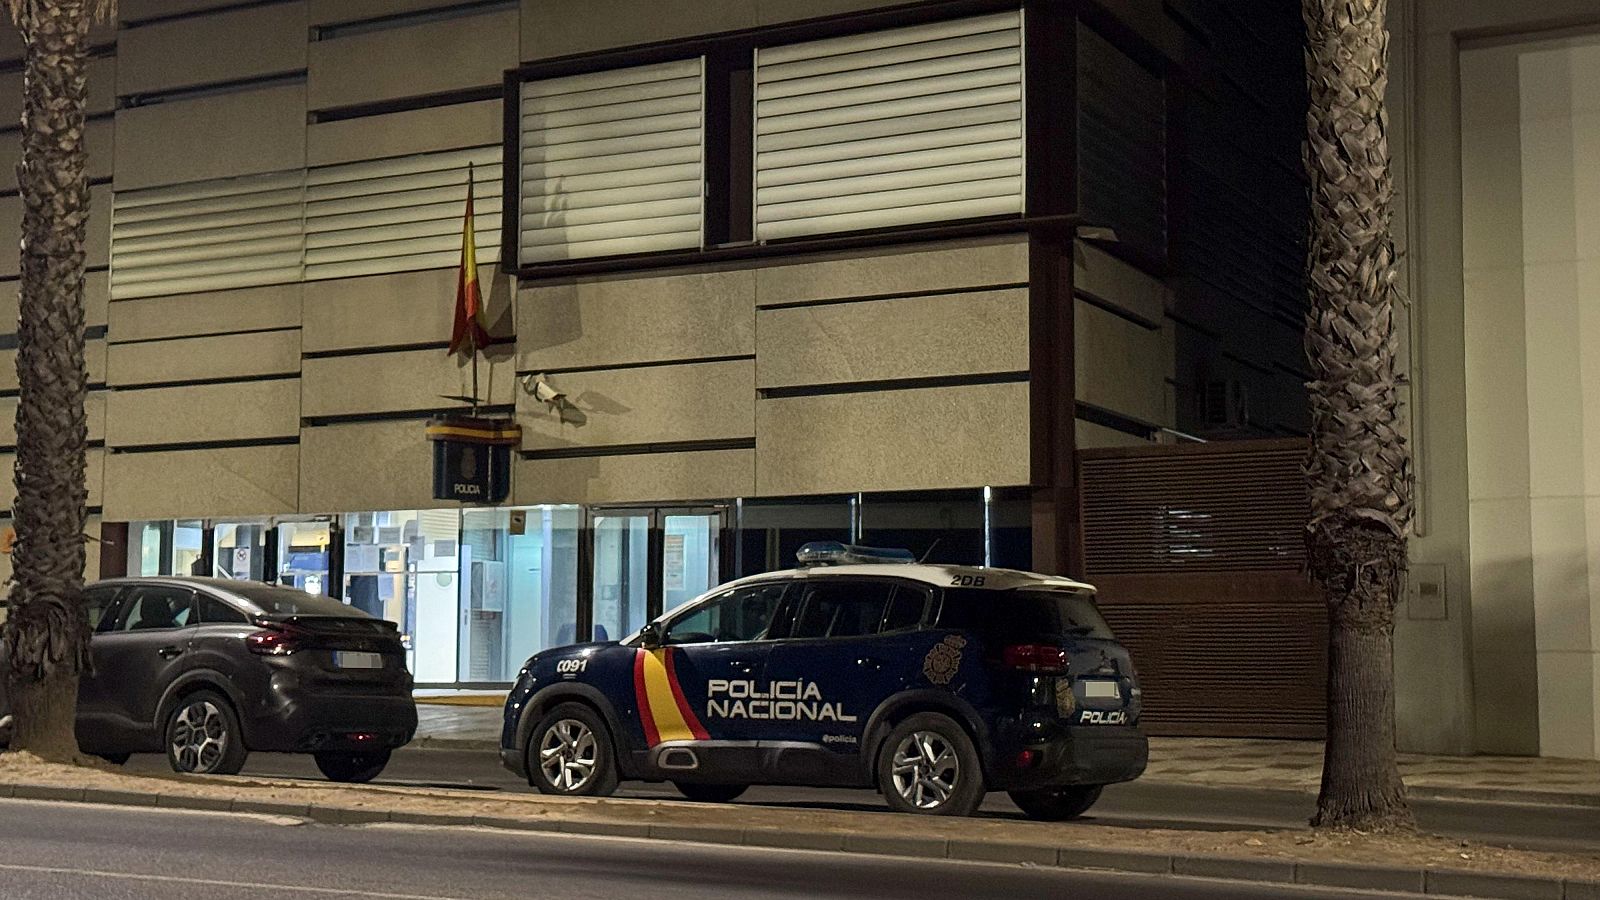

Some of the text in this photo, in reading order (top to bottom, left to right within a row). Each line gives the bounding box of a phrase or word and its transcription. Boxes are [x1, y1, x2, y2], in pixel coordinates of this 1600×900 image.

[951, 574, 985, 587] 2DB
[708, 678, 822, 700] POLICÍA
[707, 699, 857, 722] NACIONAL
